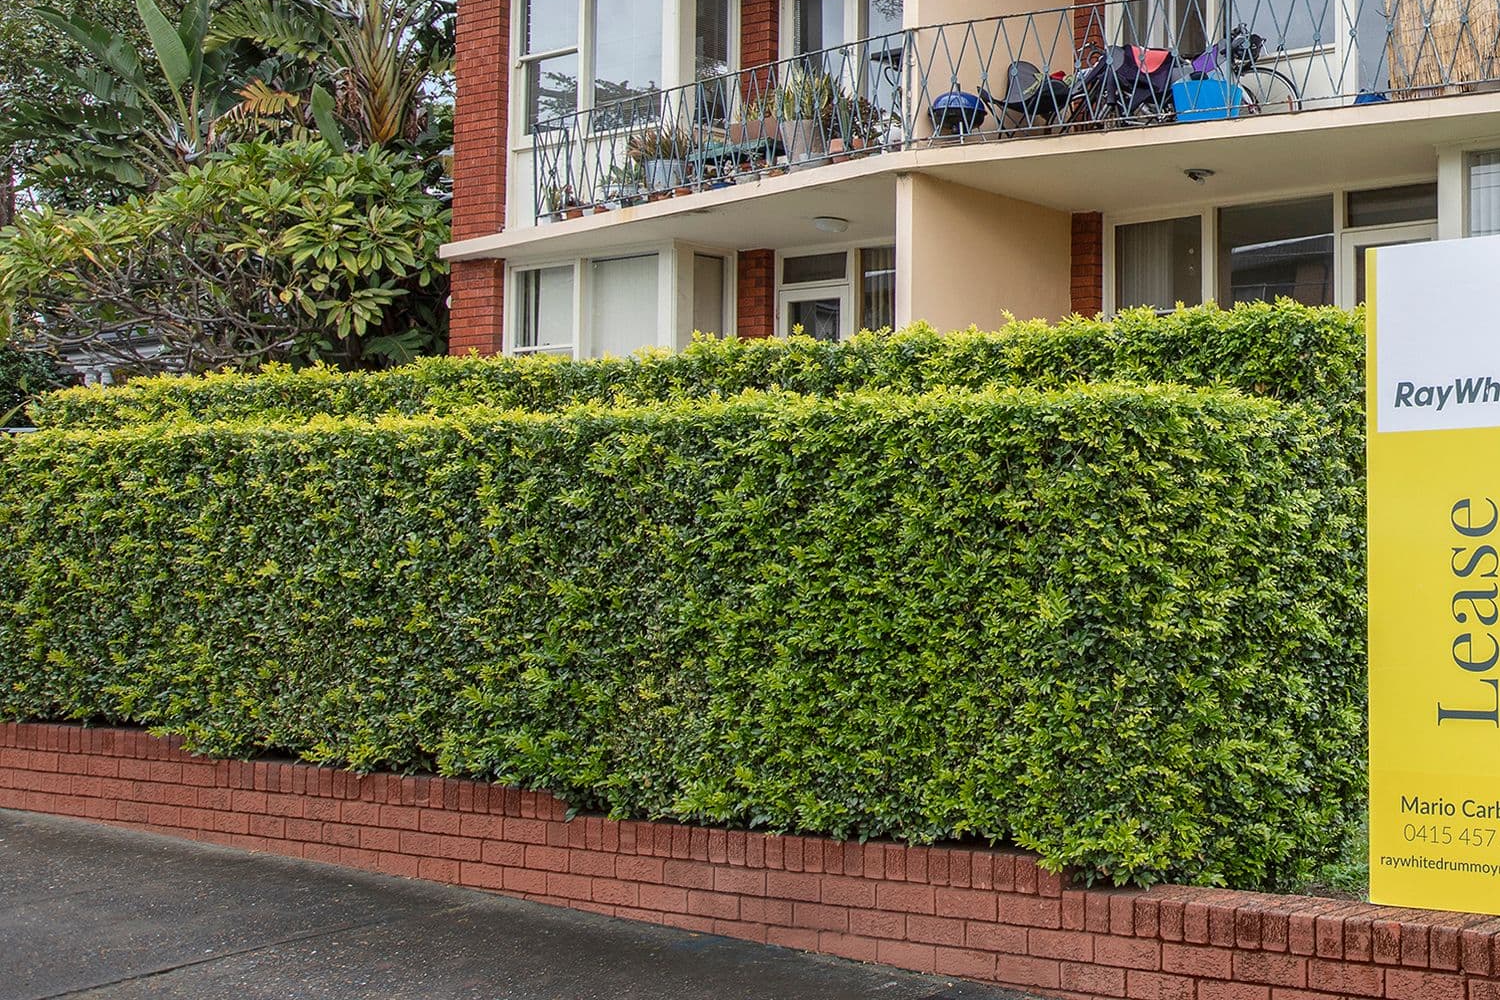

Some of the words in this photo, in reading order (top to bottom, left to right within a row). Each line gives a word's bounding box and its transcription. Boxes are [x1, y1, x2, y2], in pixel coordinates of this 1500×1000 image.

[1437, 497, 1500, 729] Lease
[1400, 795, 1456, 817] Mario
[1403, 823, 1452, 845] 0415
[1458, 827, 1496, 847] 457
